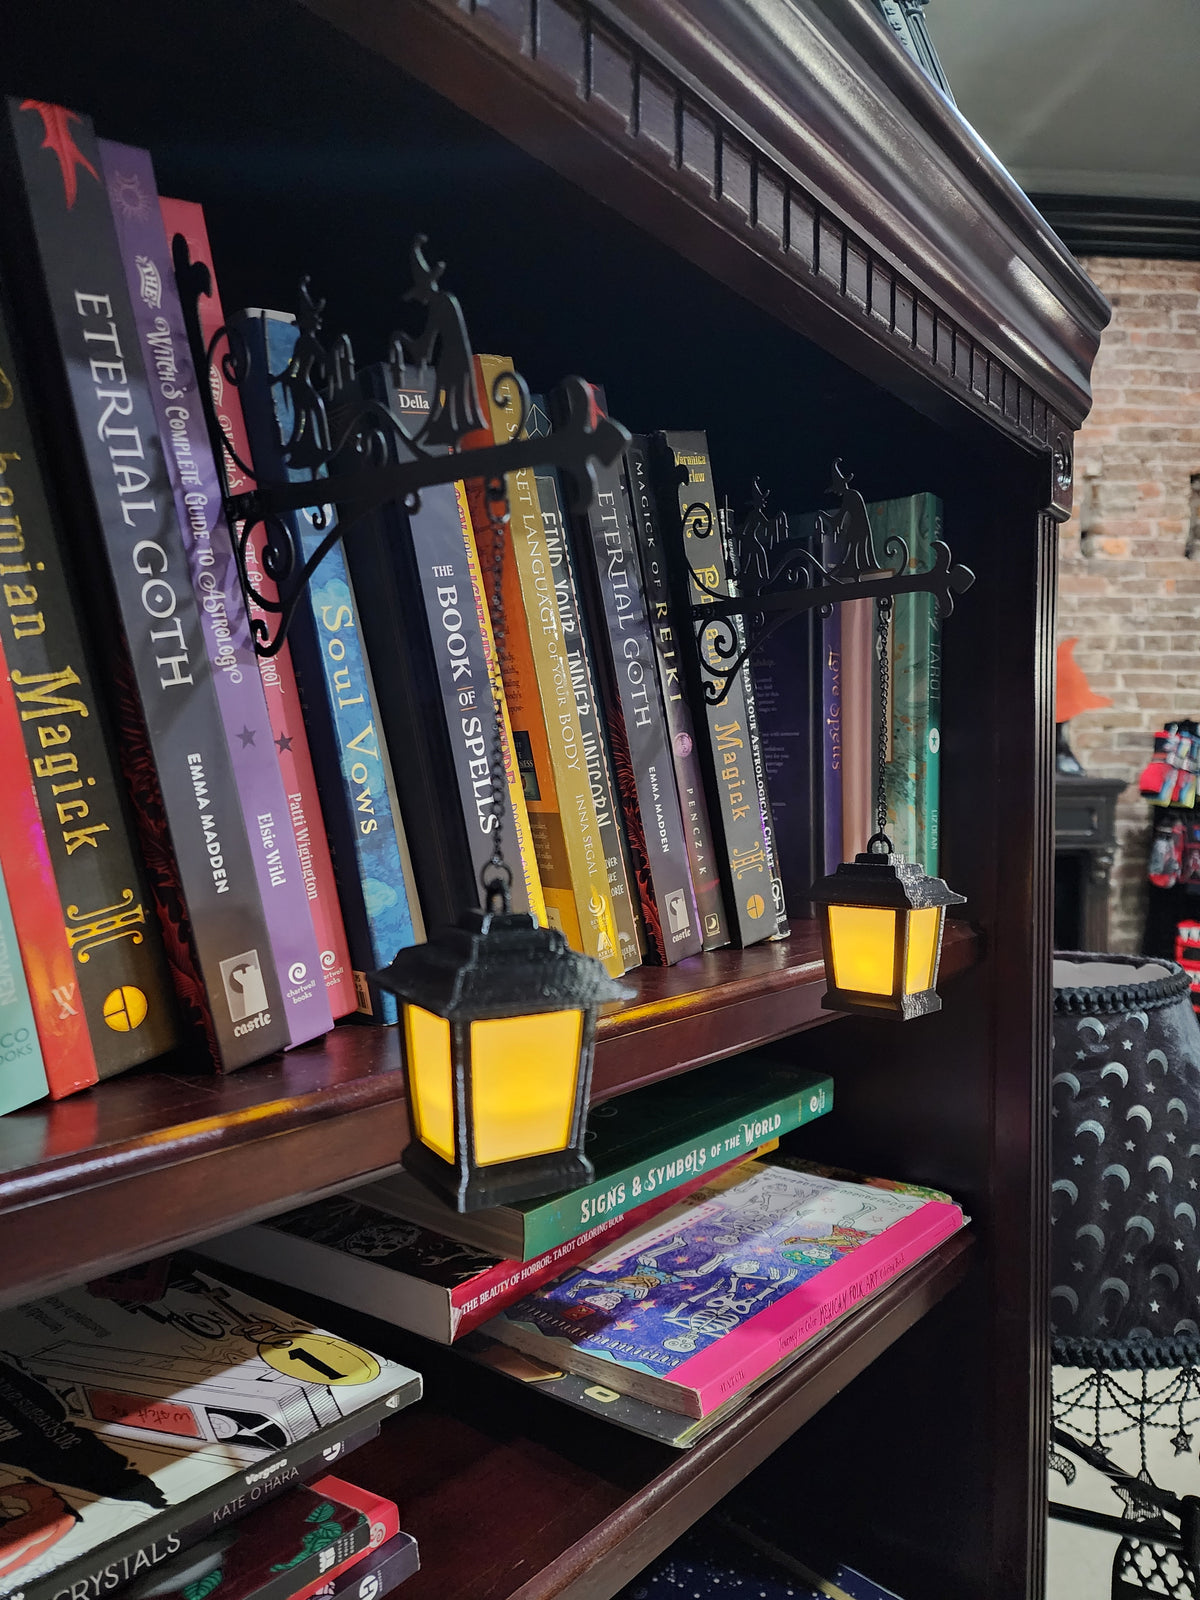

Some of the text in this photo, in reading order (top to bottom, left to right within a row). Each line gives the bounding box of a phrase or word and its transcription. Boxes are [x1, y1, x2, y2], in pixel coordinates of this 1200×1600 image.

[398, 394, 430, 410] Della
[165, 405, 201, 487] COMPLETE
[184, 491, 209, 540] GUIDE
[197, 546, 215, 567] TO
[432, 565, 454, 578] THE
[522, 514, 556, 637] LANGUAGE
[634, 461, 682, 701] MAGICK OF REIKI
[132, 540, 194, 690] GOTH
[198, 573, 243, 684] ASTROLOGY
[436, 585, 472, 682] BOOK
[541, 510, 563, 568] FIND
[567, 648, 590, 716] INNER
[582, 732, 611, 830] UNICORN
[547, 641, 561, 665] OF
[552, 664, 570, 704] YOUR
[622, 637, 652, 728] GOTH
[742, 657, 753, 690] READ
[320, 603, 378, 835] Soul Vows
[458, 690, 475, 707] OF
[746, 690, 758, 731] YOUR
[11, 665, 110, 856] Magick
[460, 716, 499, 835] SPELLS
[558, 714, 581, 772] BODY
[714, 721, 750, 822] Magick
[750, 732, 769, 828] ASTROLOGICAL
[187, 752, 229, 894] EMMA MADDEN
[288, 793, 319, 900] Patti Wigington
[575, 794, 598, 877] INNA SEGAL
[648, 766, 670, 853] EMMA MADDEN
[686, 788, 708, 875] PENCZAK
[257, 813, 287, 887] Elsie Wild
[763, 827, 775, 868] CHART
[672, 929, 691, 943] castle
[233, 1011, 272, 1038] castle
[286, 980, 316, 999] chartwell
[292, 990, 313, 1004] books
[580, 1113, 783, 1224] SIGNS & SYMBOLS OF THE WORLD
[460, 1215, 625, 1312] THE BEAUTY OF HORROR: TAROT COLORING BOOK
[818, 1293, 847, 1326] MEXICAN
[849, 1281, 866, 1301] FOLK
[865, 1271, 880, 1292] ART
[288, 1347, 348, 1380] 1
[213, 1466, 300, 1523] KATE O'HARA
[245, 1458, 288, 1485] Vergara
[52, 1530, 182, 1600] CRYSTALS
